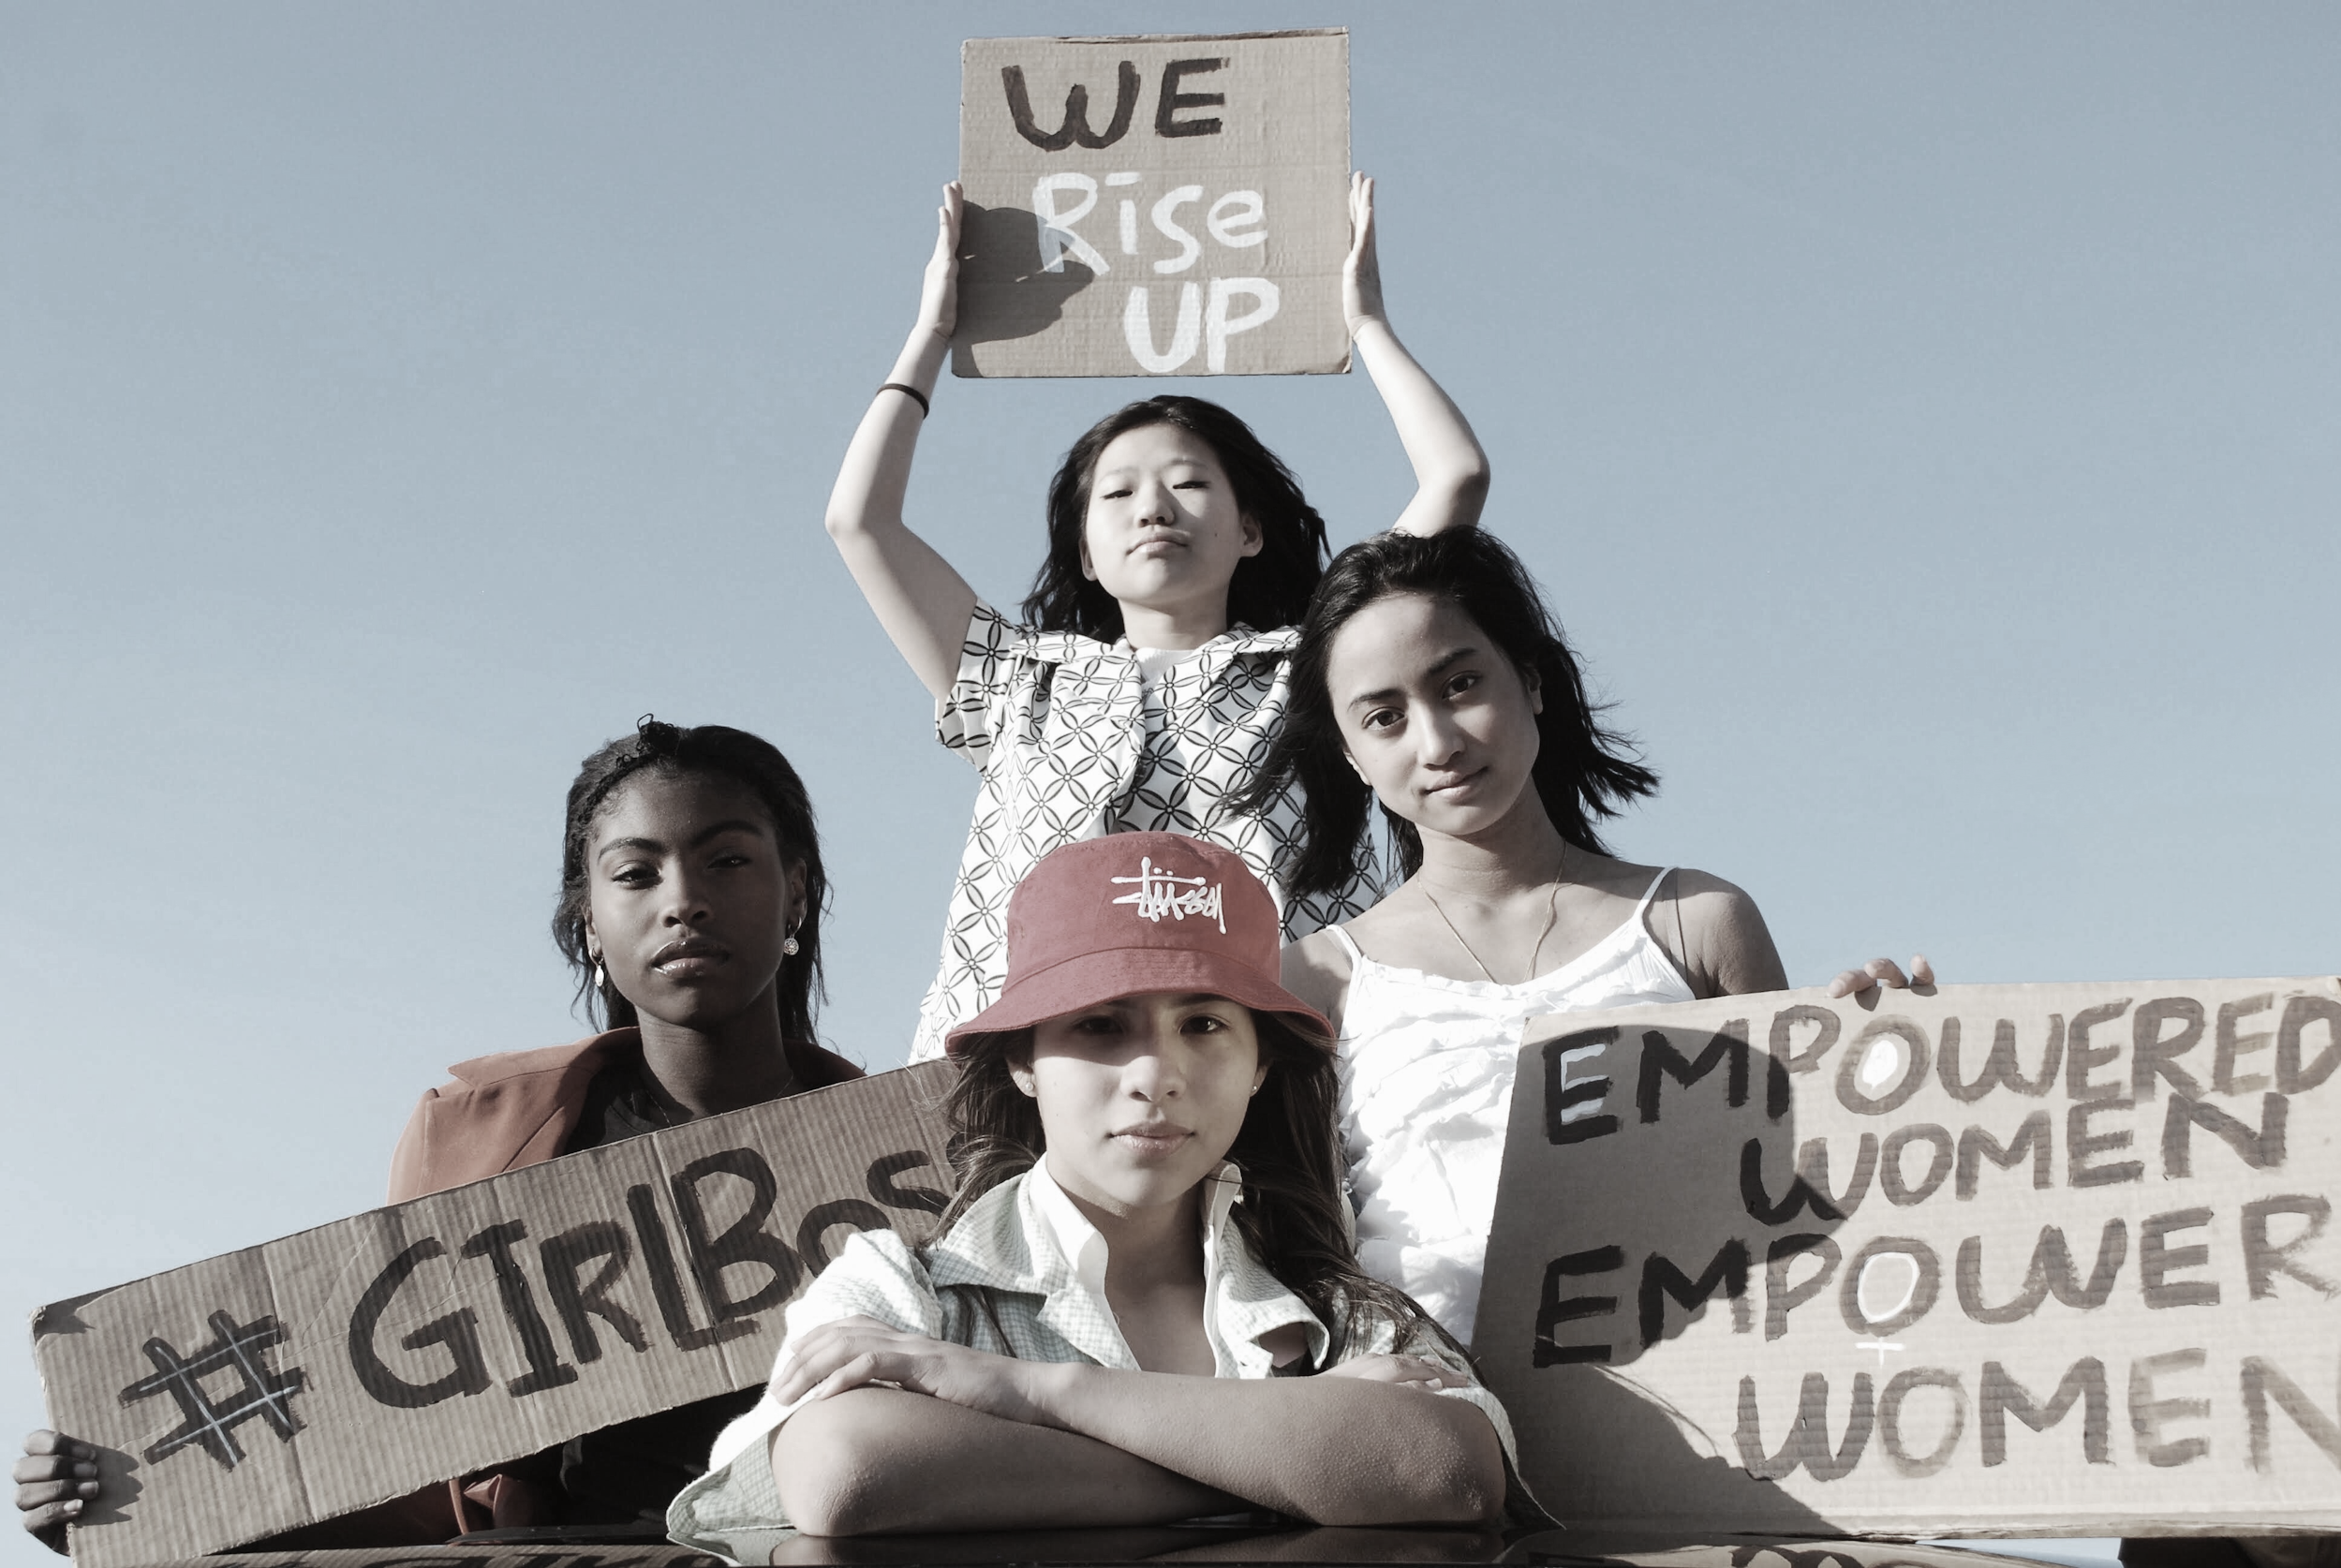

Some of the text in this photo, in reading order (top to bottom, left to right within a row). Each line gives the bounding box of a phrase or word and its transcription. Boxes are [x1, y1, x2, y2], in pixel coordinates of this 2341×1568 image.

[1001, 57, 1230, 152] WE
[1032, 171, 1268, 275] Rise
[1124, 277, 1280, 373] UP
[1543, 993, 2341, 1145] EMPOWERED
[1739, 1092, 2288, 1224] WOMEN
[1534, 1194, 2340, 1369] EMPOWER
[1733, 1347, 2341, 1483] WOMEN
